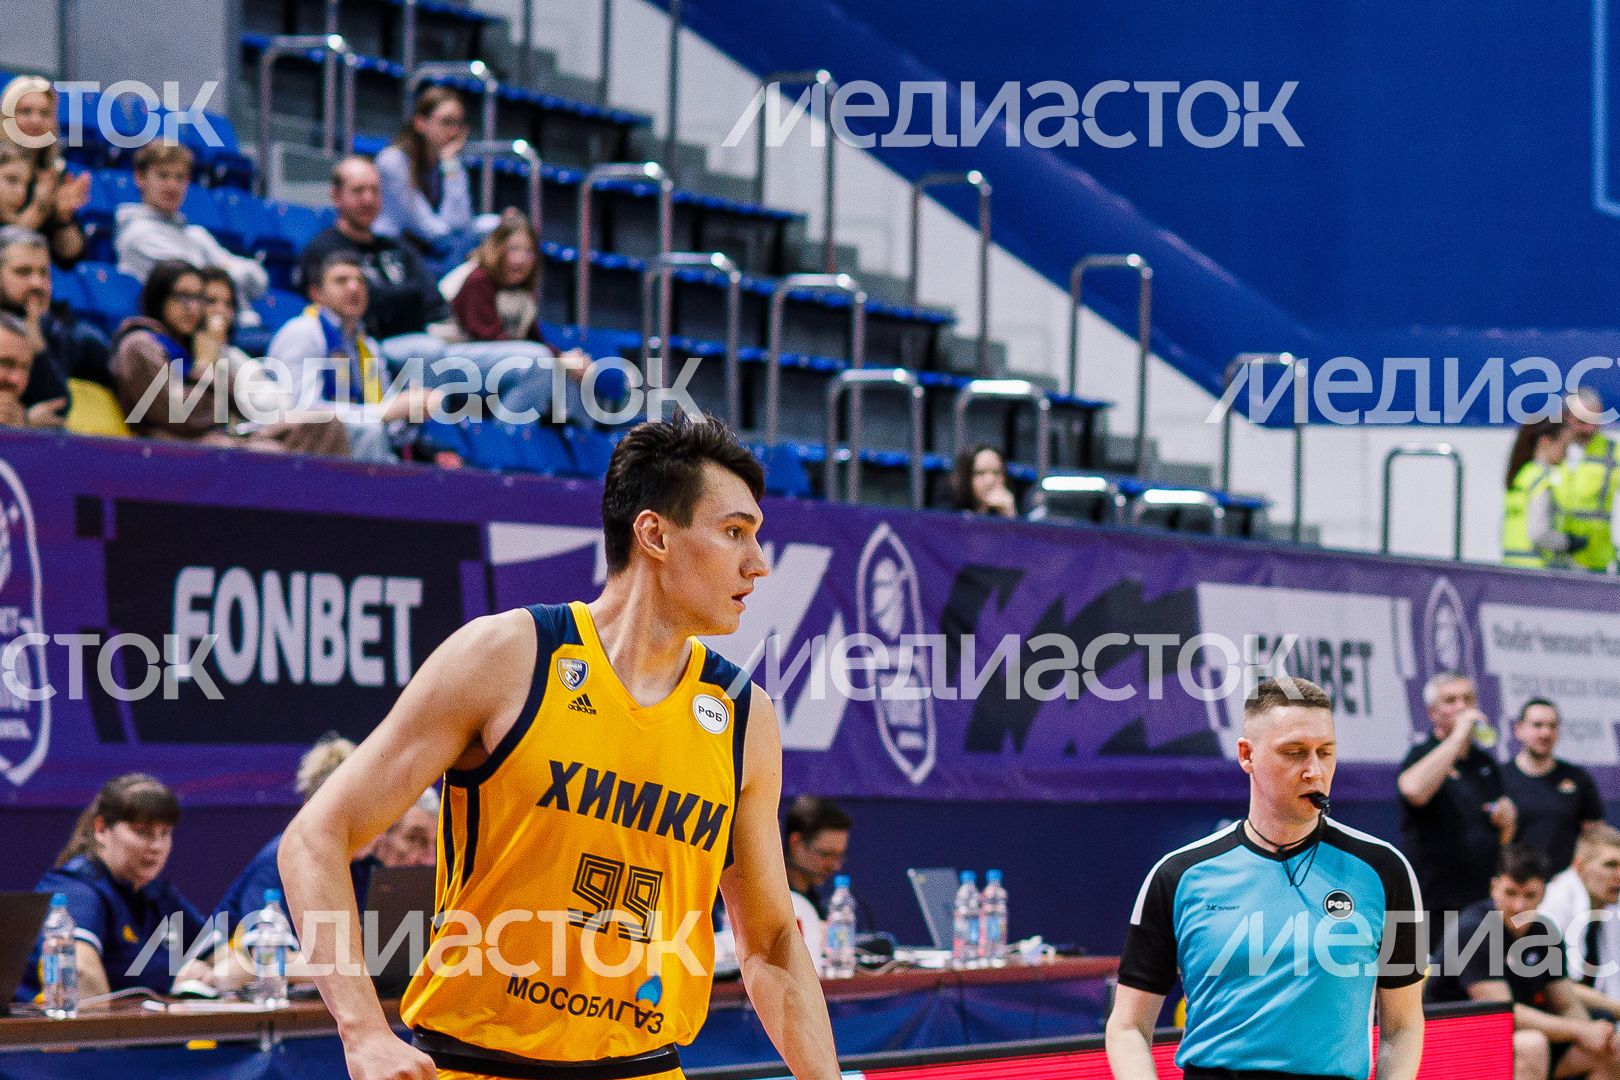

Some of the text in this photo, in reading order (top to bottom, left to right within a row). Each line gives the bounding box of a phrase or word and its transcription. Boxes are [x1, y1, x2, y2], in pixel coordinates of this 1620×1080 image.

[172, 565, 423, 688] FONBET
[567, 702, 598, 716] adidas
[698, 704, 723, 723] РФБ
[536, 759, 728, 852] ХИМКИ
[567, 852, 663, 944] 99
[1327, 900, 1351, 911] РФБ
